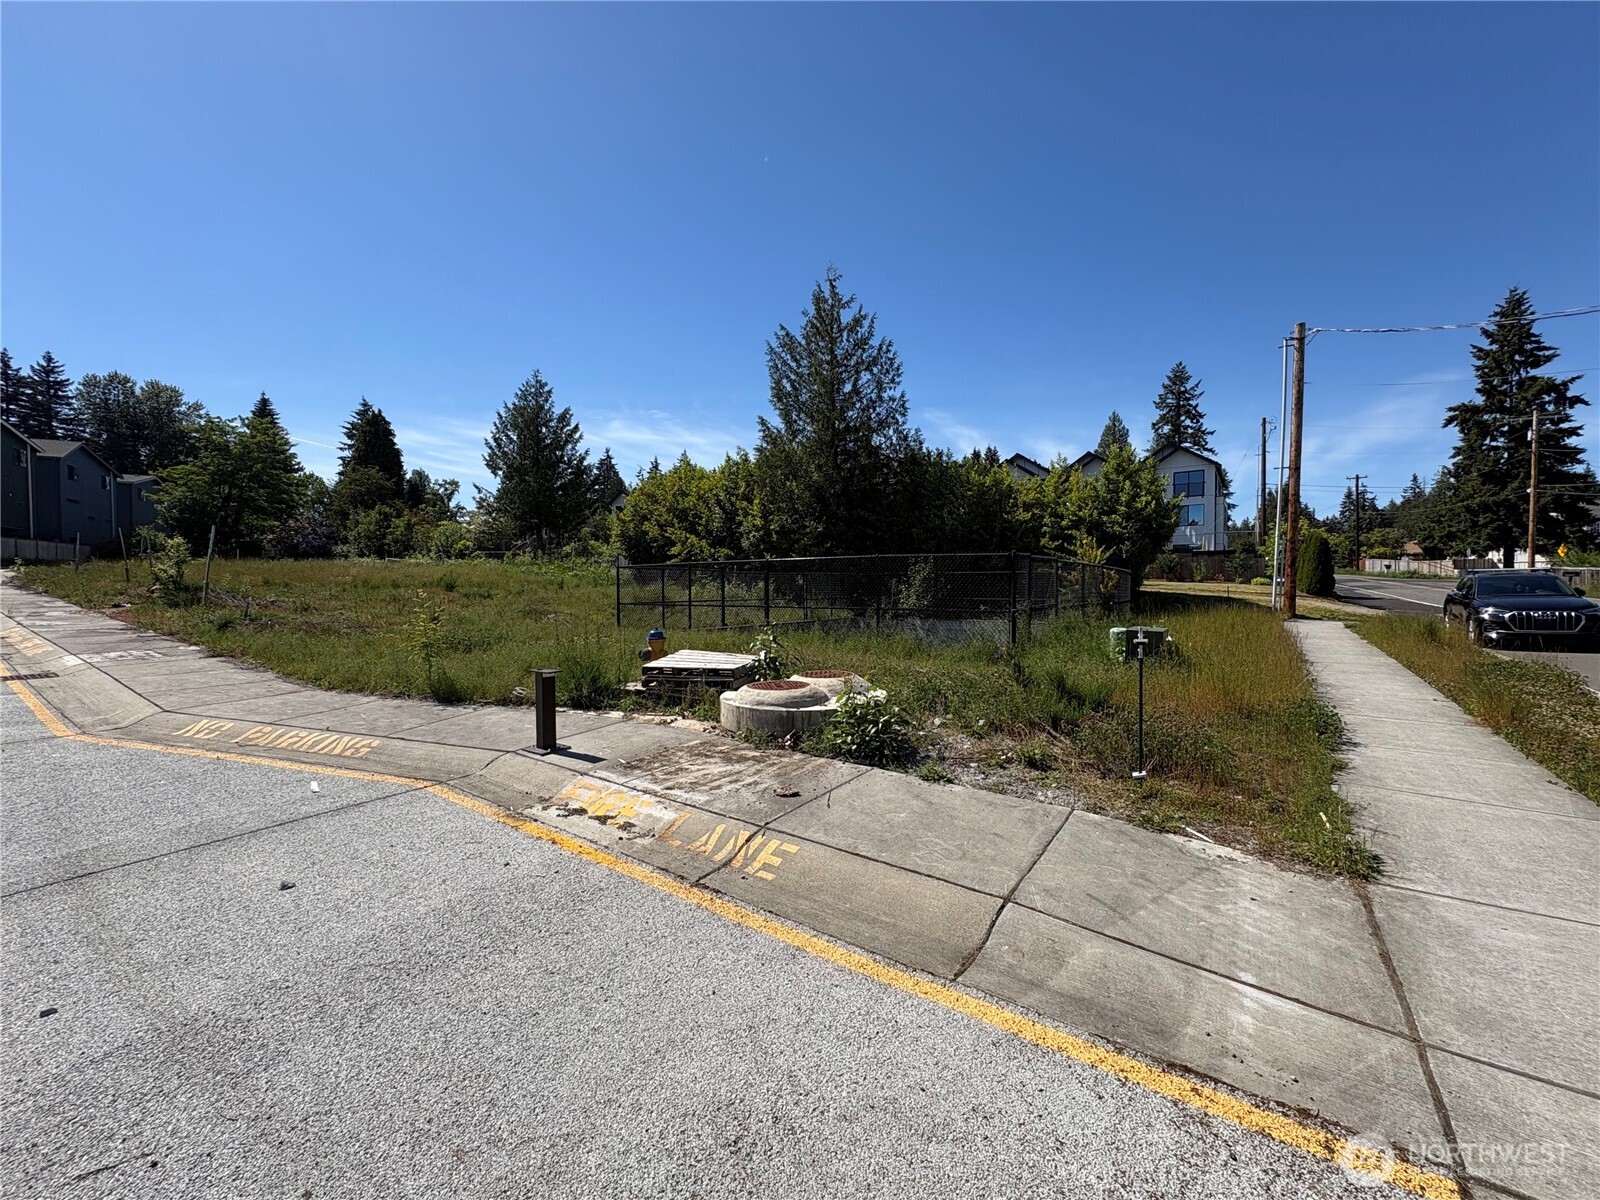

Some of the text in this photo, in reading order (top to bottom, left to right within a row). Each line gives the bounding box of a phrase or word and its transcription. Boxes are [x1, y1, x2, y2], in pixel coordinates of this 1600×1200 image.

[171, 719, 381, 758] NO PARKING
[655, 812, 801, 881] LANE
